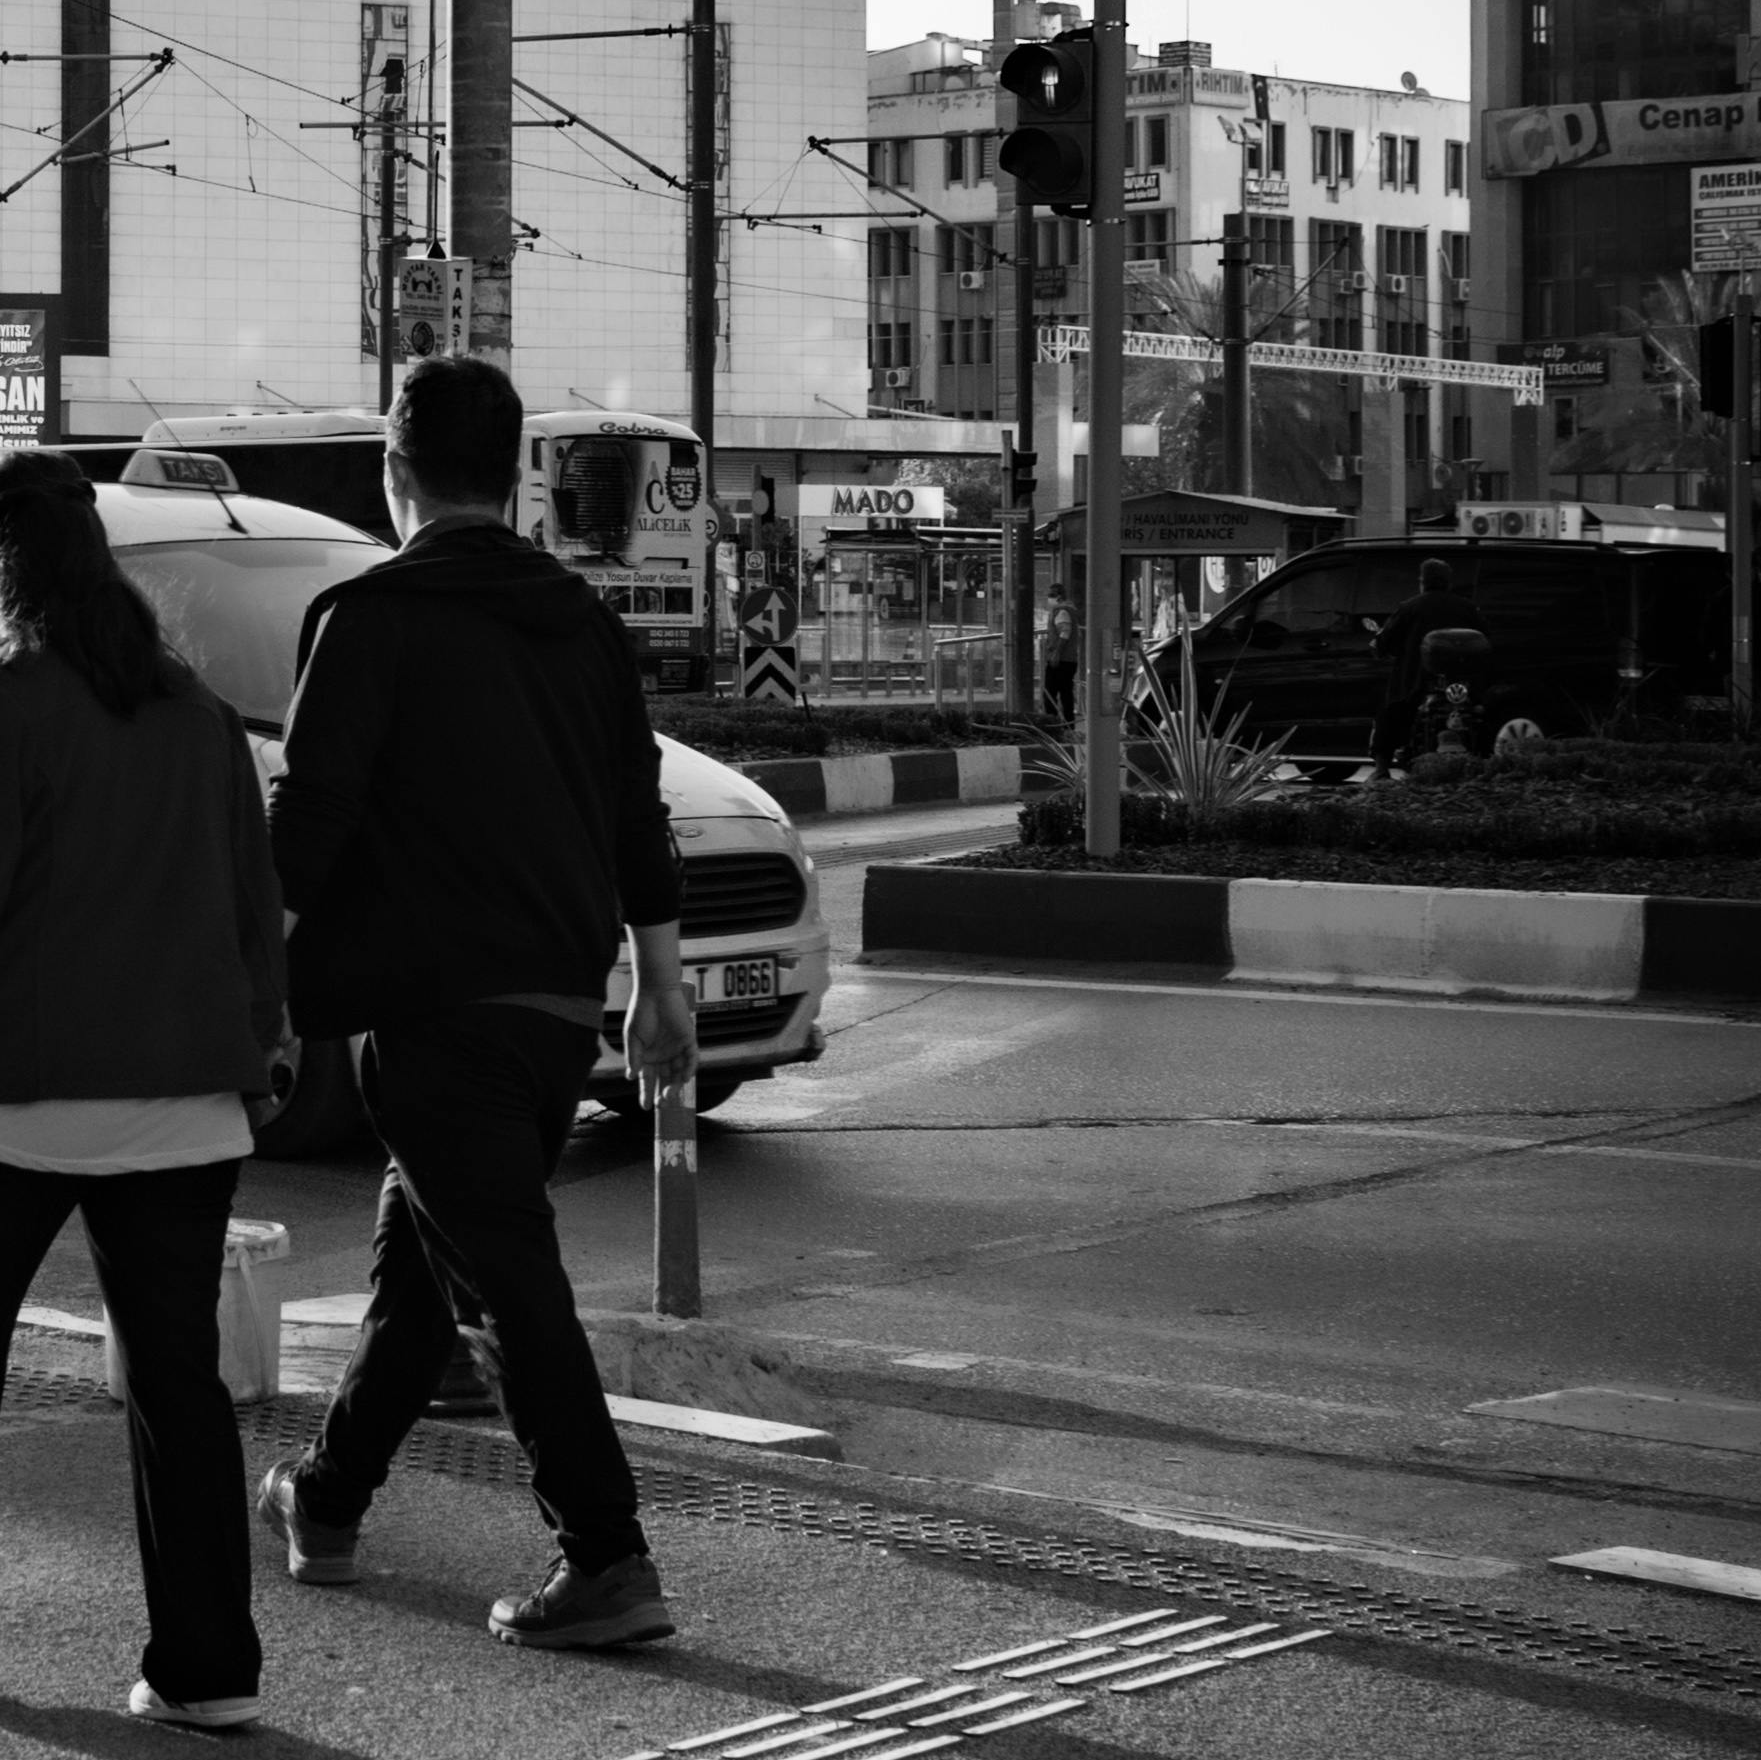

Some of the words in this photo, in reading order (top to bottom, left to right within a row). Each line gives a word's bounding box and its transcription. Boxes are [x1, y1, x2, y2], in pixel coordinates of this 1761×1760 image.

[1639, 104, 1745, 133] Cenap
[598, 421, 669, 436] Cobra
[832, 487, 915, 515] MADO
[1158, 527, 1236, 540] ENTRANCE
[696, 967, 709, 1000] T
